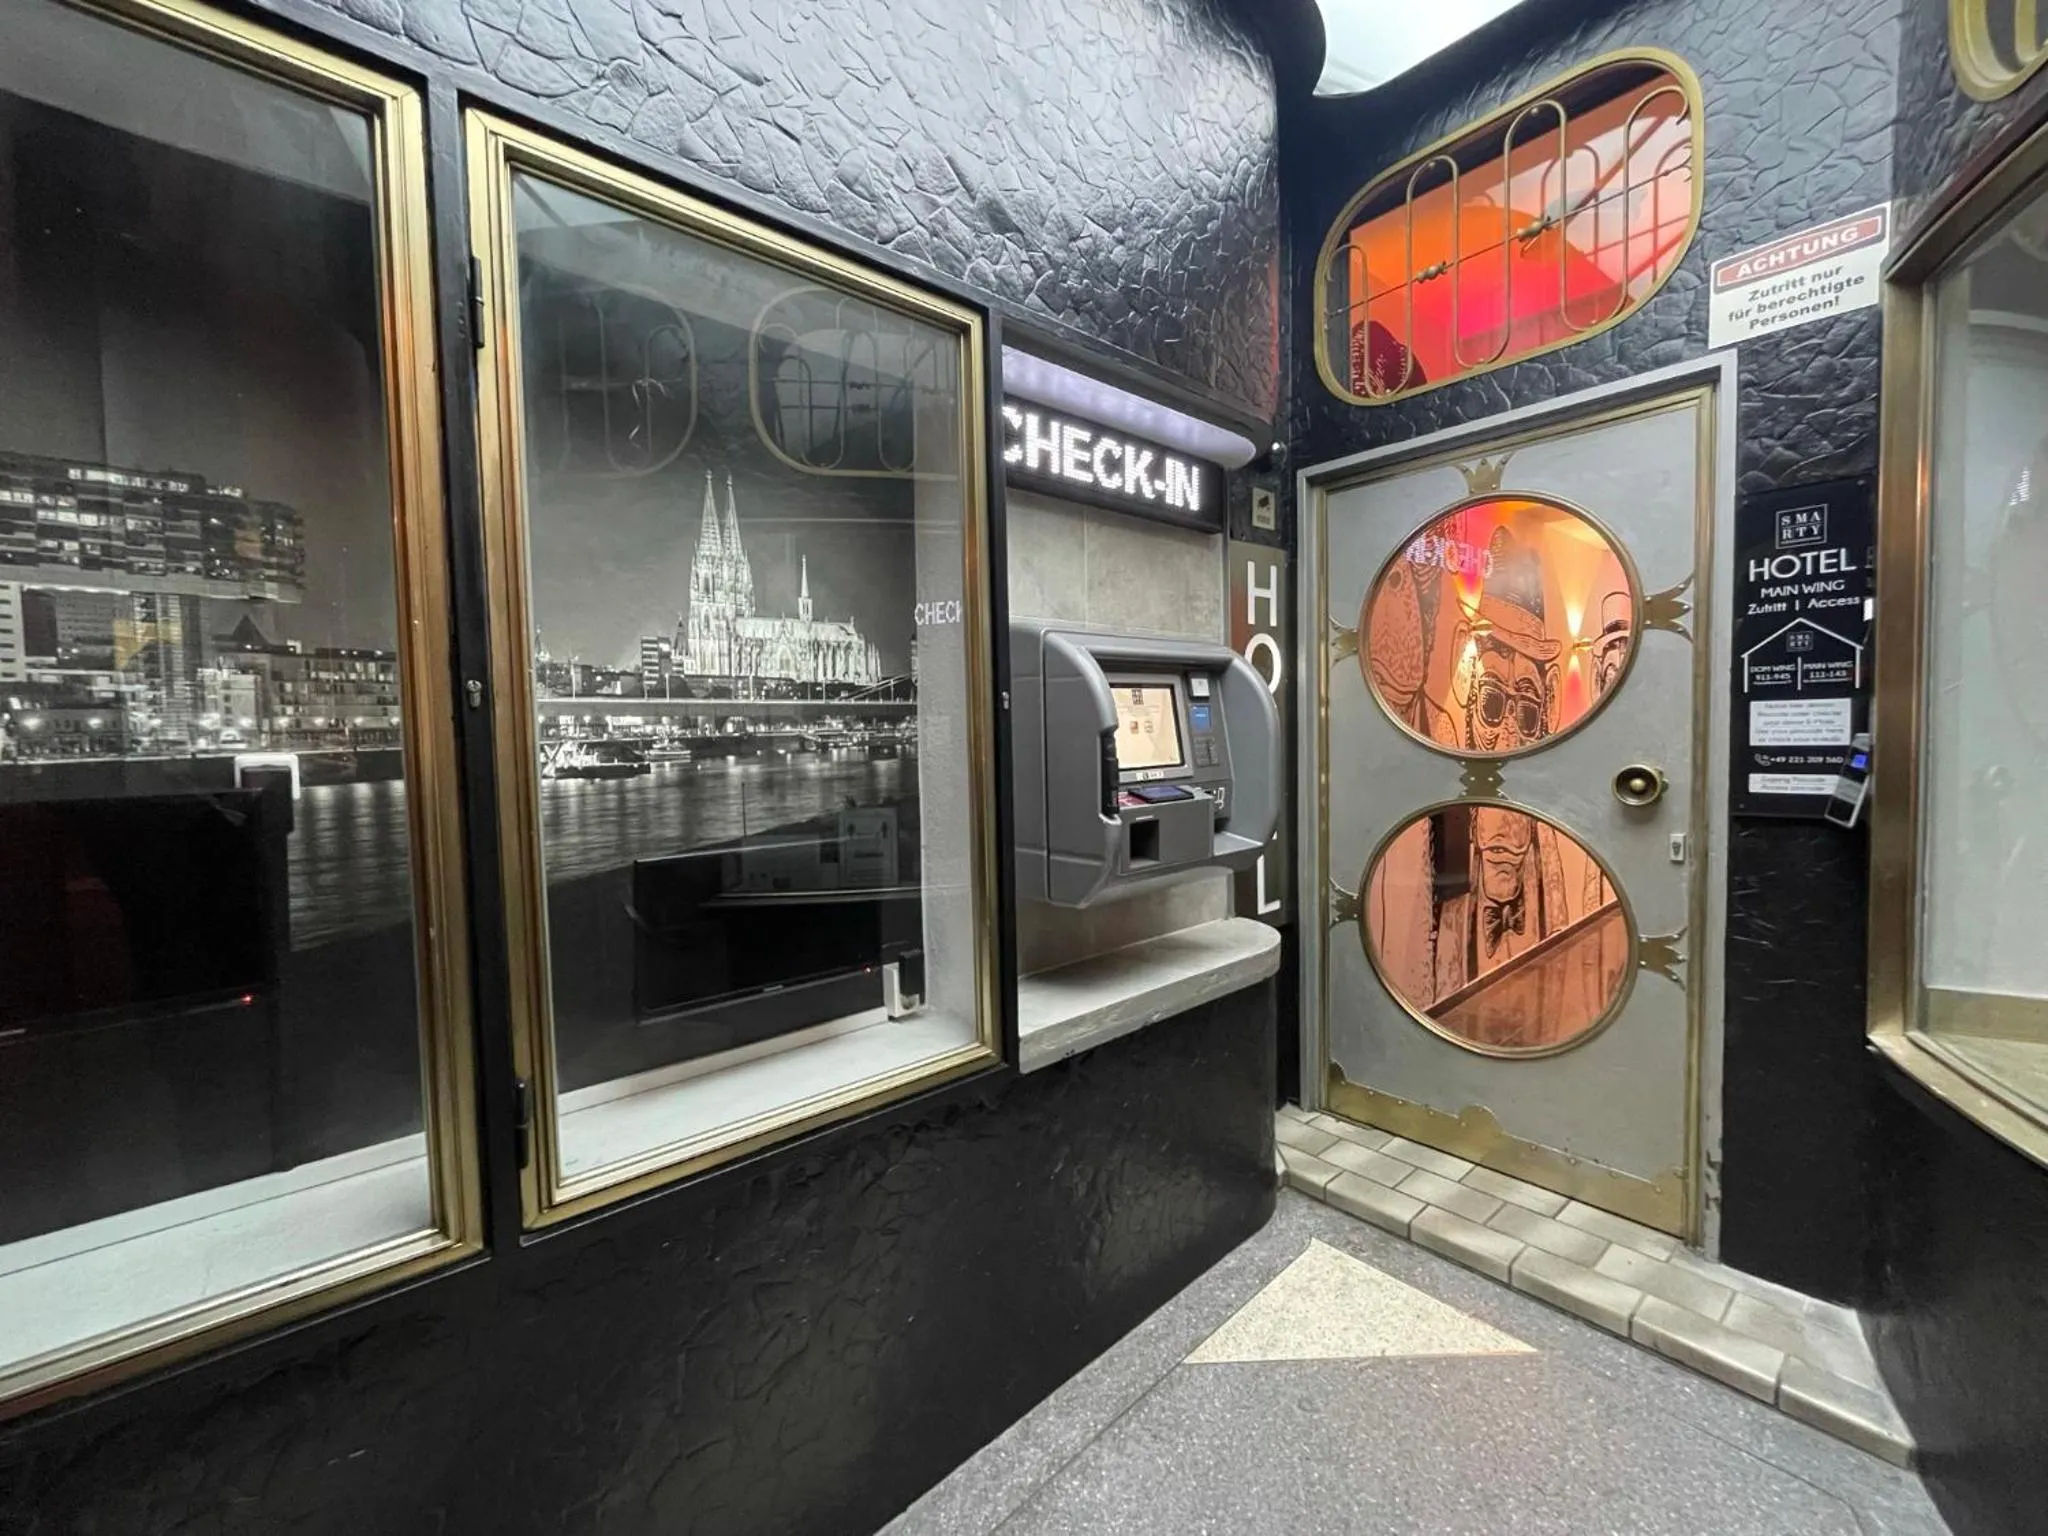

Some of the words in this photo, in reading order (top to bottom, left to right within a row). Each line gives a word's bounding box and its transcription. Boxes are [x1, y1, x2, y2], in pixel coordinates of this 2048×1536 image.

[1736, 227, 1858, 278] ACHTUNG
[1728, 307, 1752, 322] für
[1757, 275, 1865, 313] berechtigte
[1748, 277, 1805, 301] Zutritt
[1811, 265, 1843, 283] nur
[1749, 296, 1840, 329] Personen!
[1749, 548, 1857, 582] HOTEL
[1747, 602, 1787, 615] Zutritt
[1807, 596, 1860, 609] Access
[1760, 584, 1799, 598] MAIN
[1802, 579, 1845, 594] WING
[1244, 561, 1281, 915] HOL
